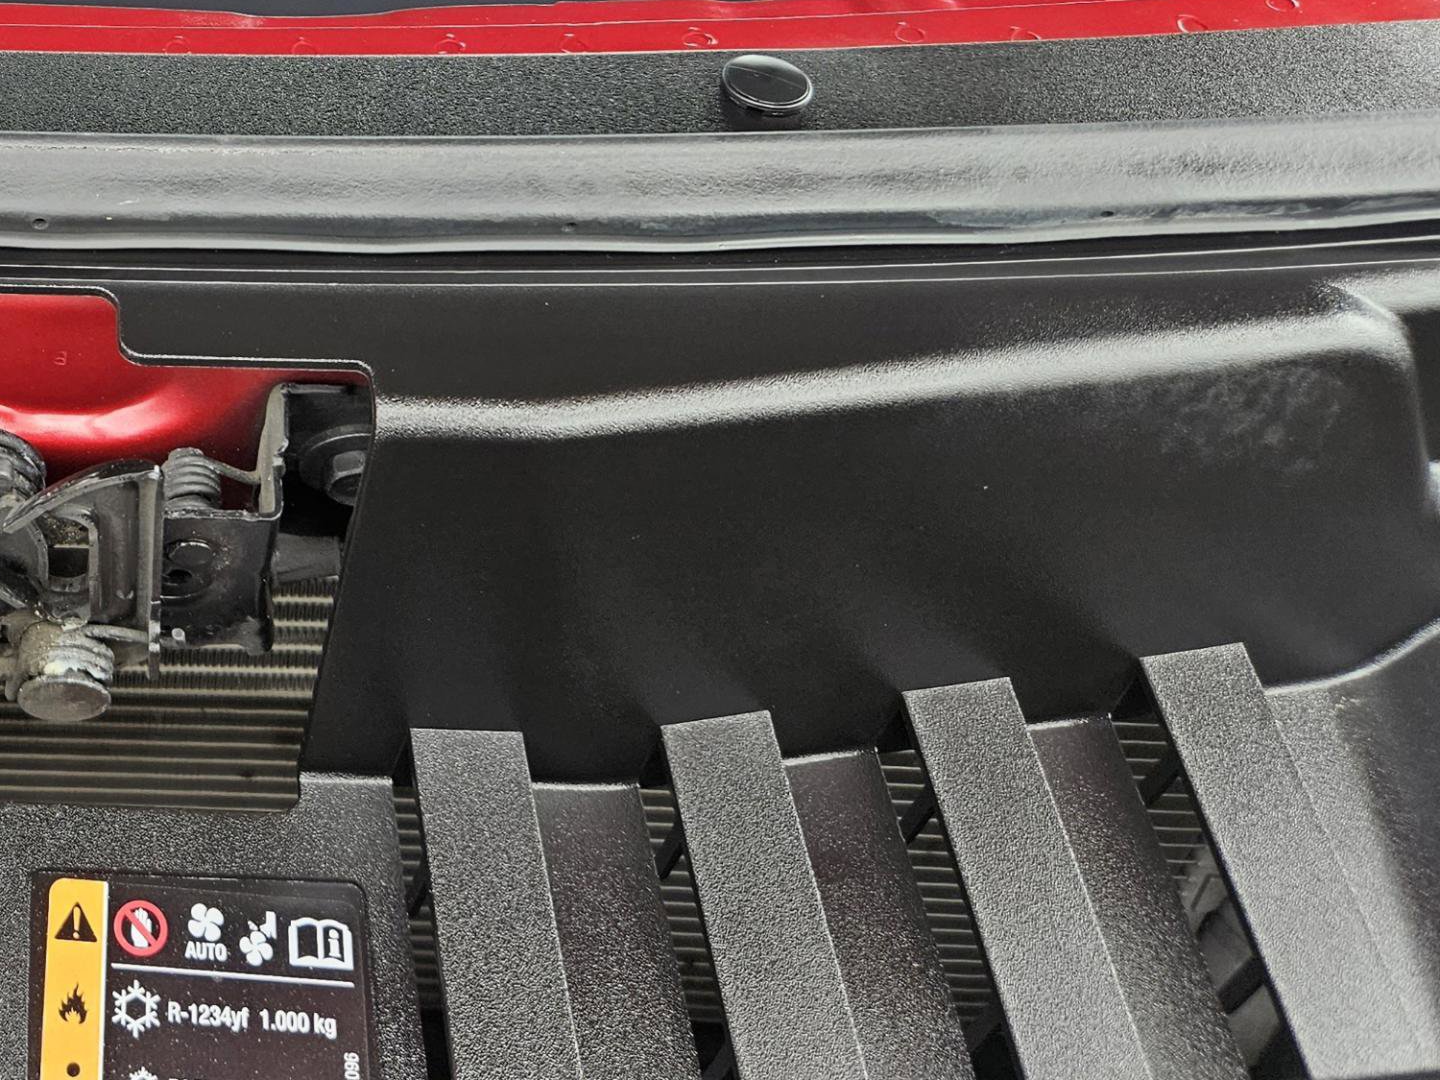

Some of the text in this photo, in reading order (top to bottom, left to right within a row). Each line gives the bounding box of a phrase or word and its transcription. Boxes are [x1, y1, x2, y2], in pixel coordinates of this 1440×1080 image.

[185, 940, 228, 962] AUTO
[167, 1000, 338, 1040] R-1234yf 1.000 kg
